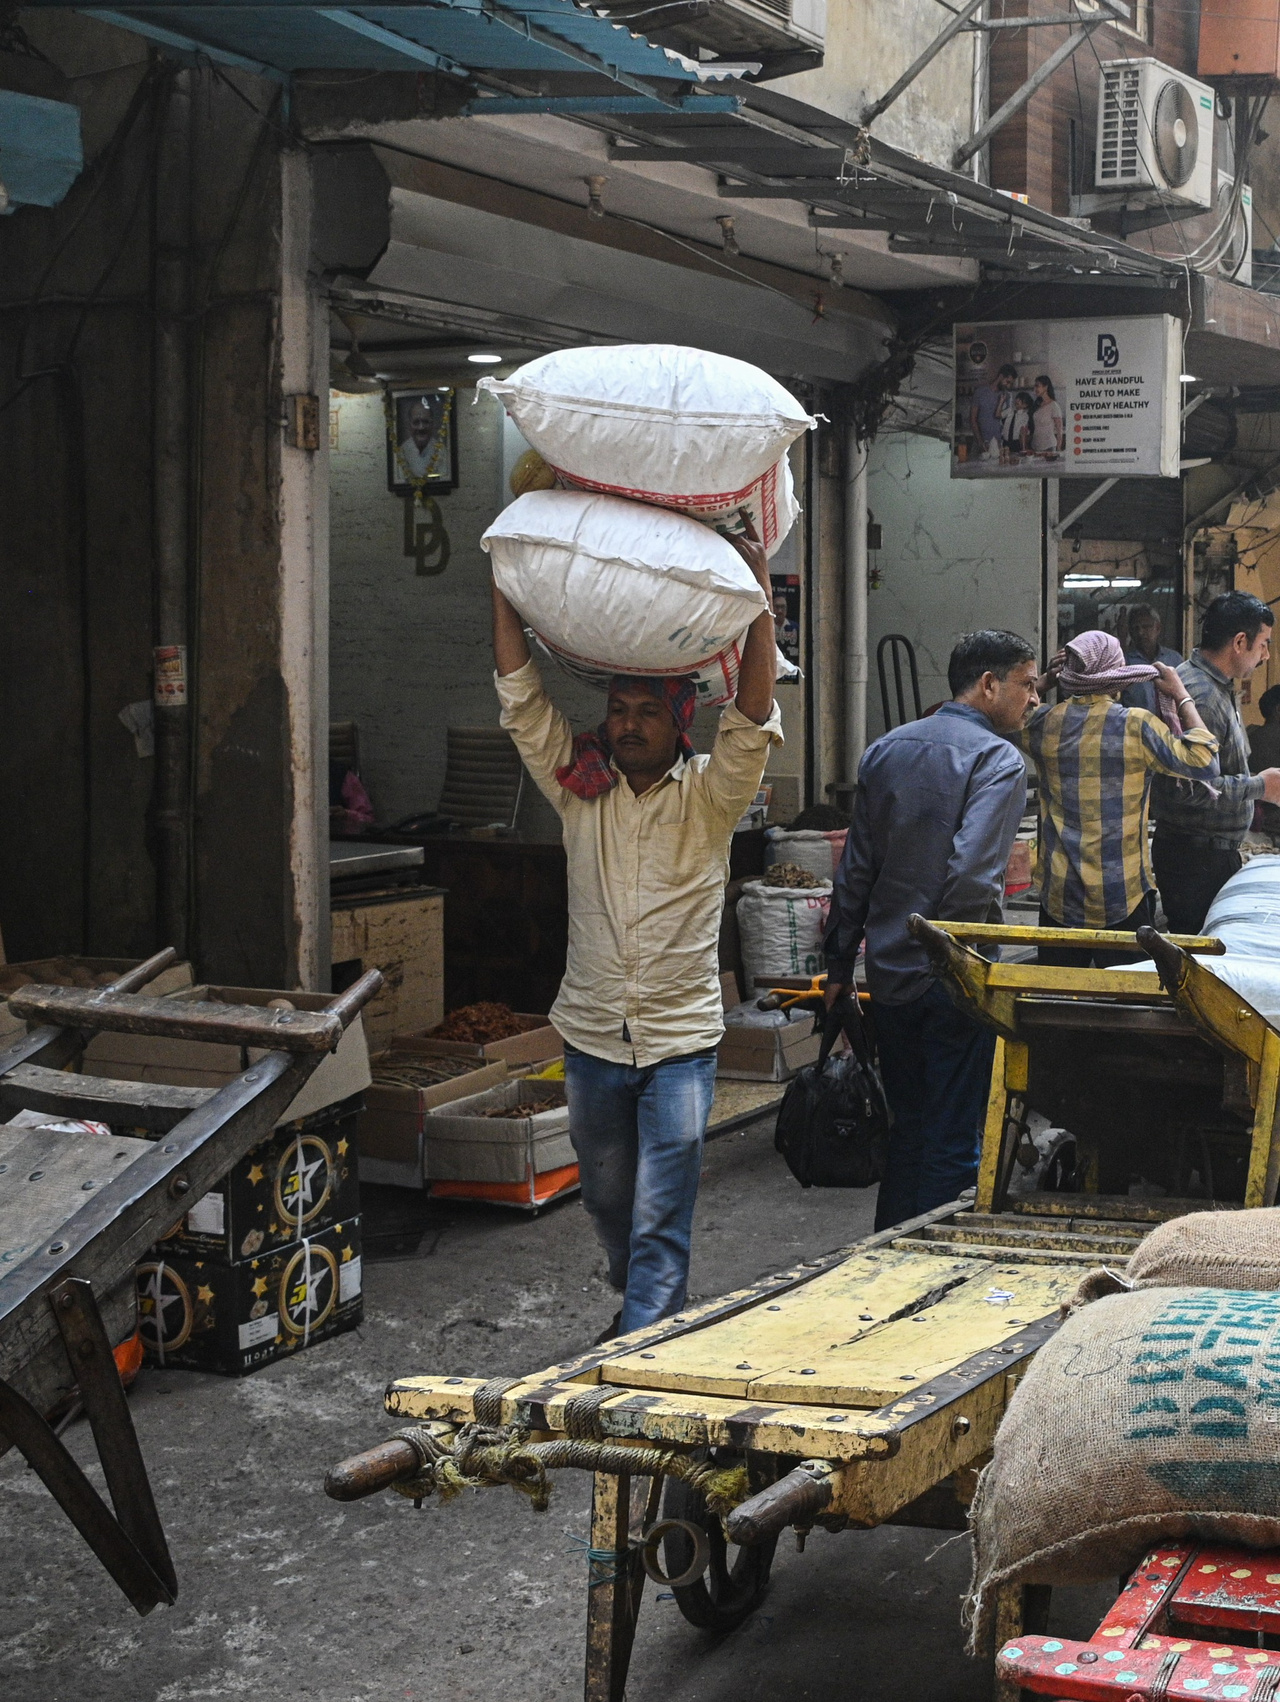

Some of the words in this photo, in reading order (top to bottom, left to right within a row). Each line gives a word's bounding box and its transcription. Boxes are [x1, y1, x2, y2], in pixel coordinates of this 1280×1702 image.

[1075, 378, 1097, 386] HAVE
[1106, 376, 1144, 385] HANDFUL
[1080, 390, 1103, 398] DAILY
[1104, 389, 1115, 397] TO
[1117, 388, 1140, 397] MAKE
[1070, 402, 1111, 411] EVERYDAY
[1113, 401, 1150, 409] HEALTHY
[1125, 1300, 1218, 1440] DRIED
[1190, 1301, 1280, 1439] DATES
